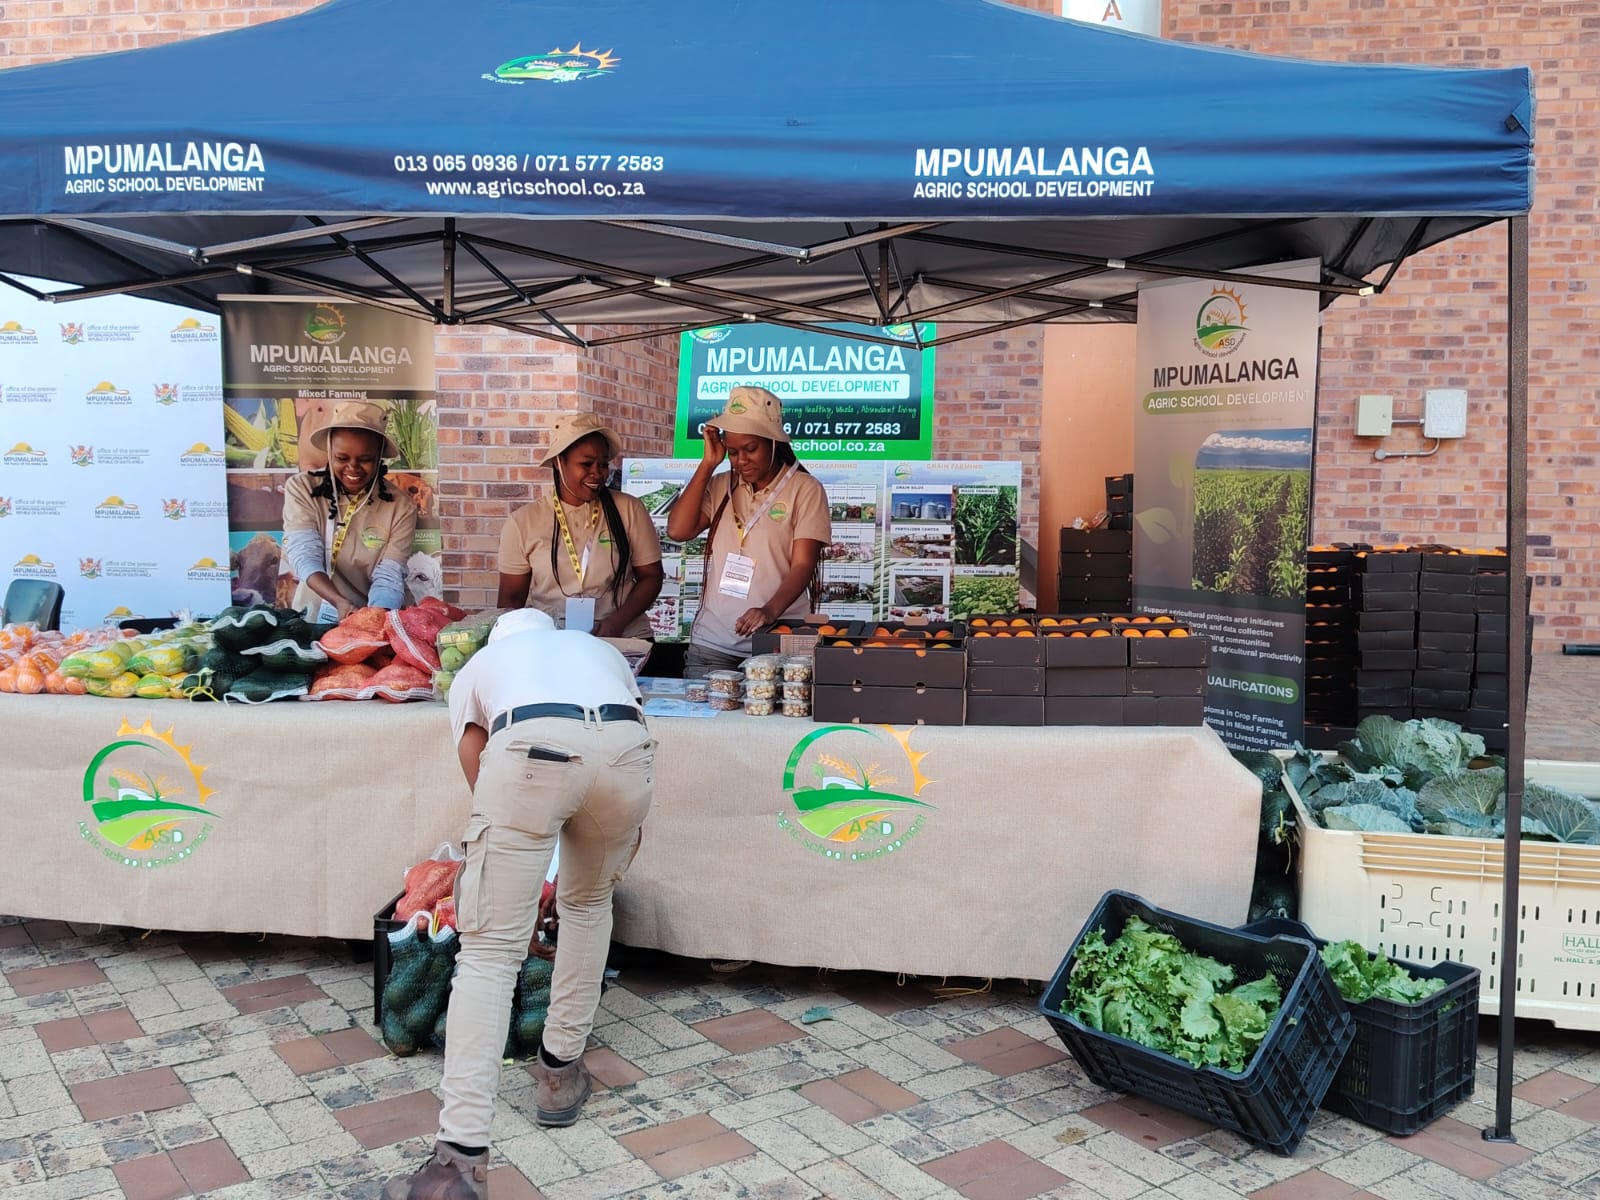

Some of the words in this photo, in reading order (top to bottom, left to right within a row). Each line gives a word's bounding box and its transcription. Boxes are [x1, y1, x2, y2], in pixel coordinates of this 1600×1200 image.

[64, 142, 265, 175] MPUMALANGA
[394, 155, 428, 171] 013
[433, 155, 467, 171] 065
[471, 155, 518, 172] 0936
[522, 154, 529, 172] /
[535, 155, 570, 171] 071
[575, 155, 612, 171] 577
[617, 156, 664, 172] 2583
[914, 147, 1155, 177] MPUMALANGA
[65, 178, 104, 194] AGRIC
[108, 177, 164, 193] SCHOOL
[166, 176, 265, 192] DEVELOPMENT
[426, 178, 645, 198] www.agricschool.co.za
[913, 182, 963, 198] AGRIC
[966, 181, 1031, 198] SCHOOL
[1036, 180, 1155, 197] DEVELOPMENT
[250, 344, 413, 365] MPUMALANGA
[706, 346, 906, 373] MPUMALANGA
[263, 365, 291, 373] AGRIC
[293, 365, 329, 373] SCHOOL
[331, 366, 396, 374] DEVELOPMENT
[1153, 357, 1300, 388] MPUMALANGA
[298, 389, 327, 398] Mixed
[328, 390, 367, 400] Farming
[802, 380, 900, 393] DEVELOPMENT
[1148, 397, 1178, 410] AGRIC
[1180, 394, 1224, 408] SCHOOL
[1226, 389, 1311, 405] DEVELOPMENT
[804, 422, 831, 435] 071
[834, 422, 861, 435] 577
[865, 422, 901, 435] 2583
[1143, 605, 1168, 614] Support
[1169, 608, 1206, 619] agricultural
[1206, 613, 1233, 623] projects
[1233, 616, 1248, 624] and
[1249, 616, 1285, 628] initiatives
[1209, 623, 1222, 631] and
[1223, 625, 1237, 633] data
[1237, 627, 1274, 638] collection
[1225, 636, 1271, 648] communities
[1218, 645, 1258, 657] agricultural
[1258, 650, 1303, 664] productivity
[1207, 675, 1294, 699] UALIFICATIONS
[1203, 705, 1225, 715] ploma
[1226, 708, 1233, 716] in
[1234, 710, 1251, 721] Crop
[1252, 713, 1284, 728] Farming
[1203, 716, 1225, 727] ploma
[1226, 719, 1233, 727] in
[1234, 721, 1255, 733] Mixed
[1256, 726, 1288, 740] Farming
[1226, 730, 1233, 738] in
[1234, 732, 1269, 746] Livestock
[143, 829, 184, 845] ASD
[775, 810, 800, 842] Agric
[802, 838, 845, 862] school
[850, 813, 928, 864] development
[849, 819, 895, 836] ASD
[76, 820, 102, 850] Agric
[103, 847, 143, 869] school
[145, 821, 214, 869] development
